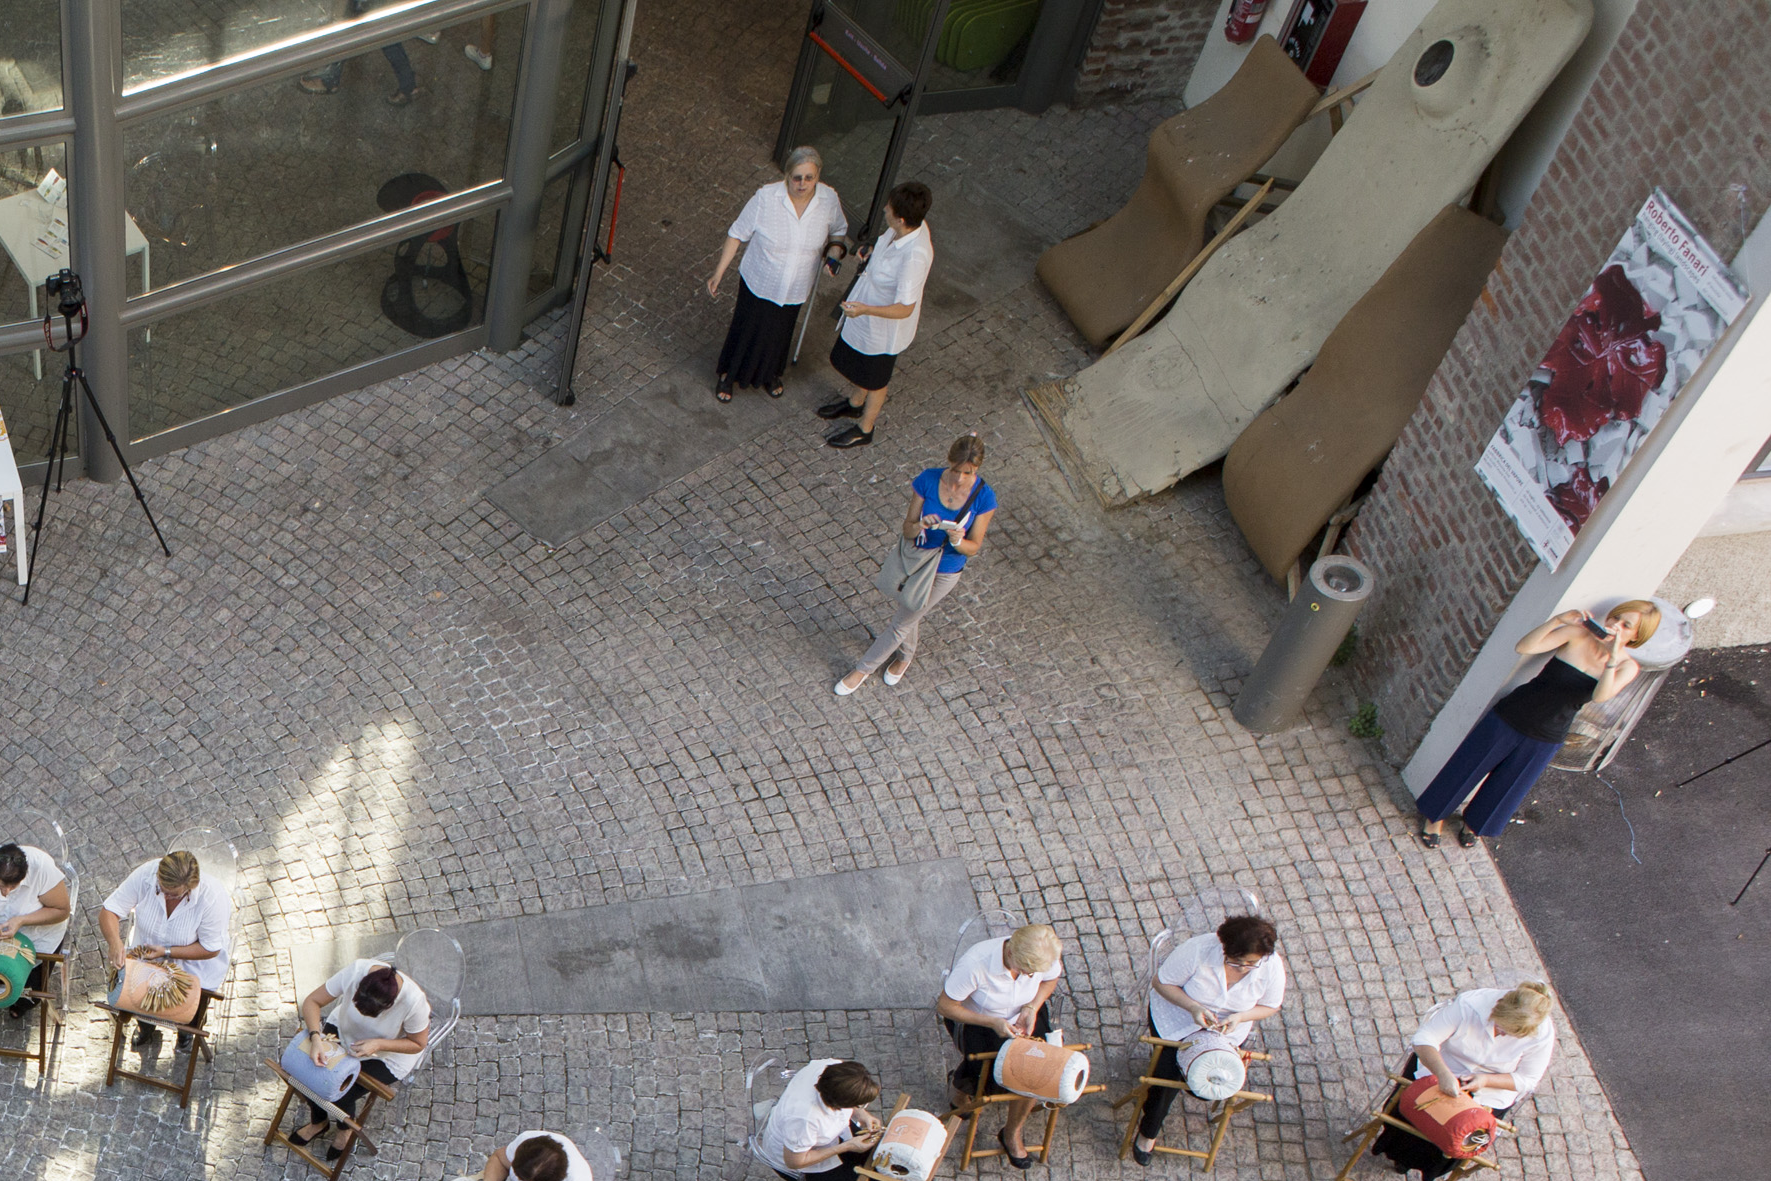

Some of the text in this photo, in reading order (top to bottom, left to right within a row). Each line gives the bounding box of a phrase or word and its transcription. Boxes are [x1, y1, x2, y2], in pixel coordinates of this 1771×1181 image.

[1646, 200, 1709, 277] Roberto Fanari
[1674, 251, 1700, 284] landscapes
